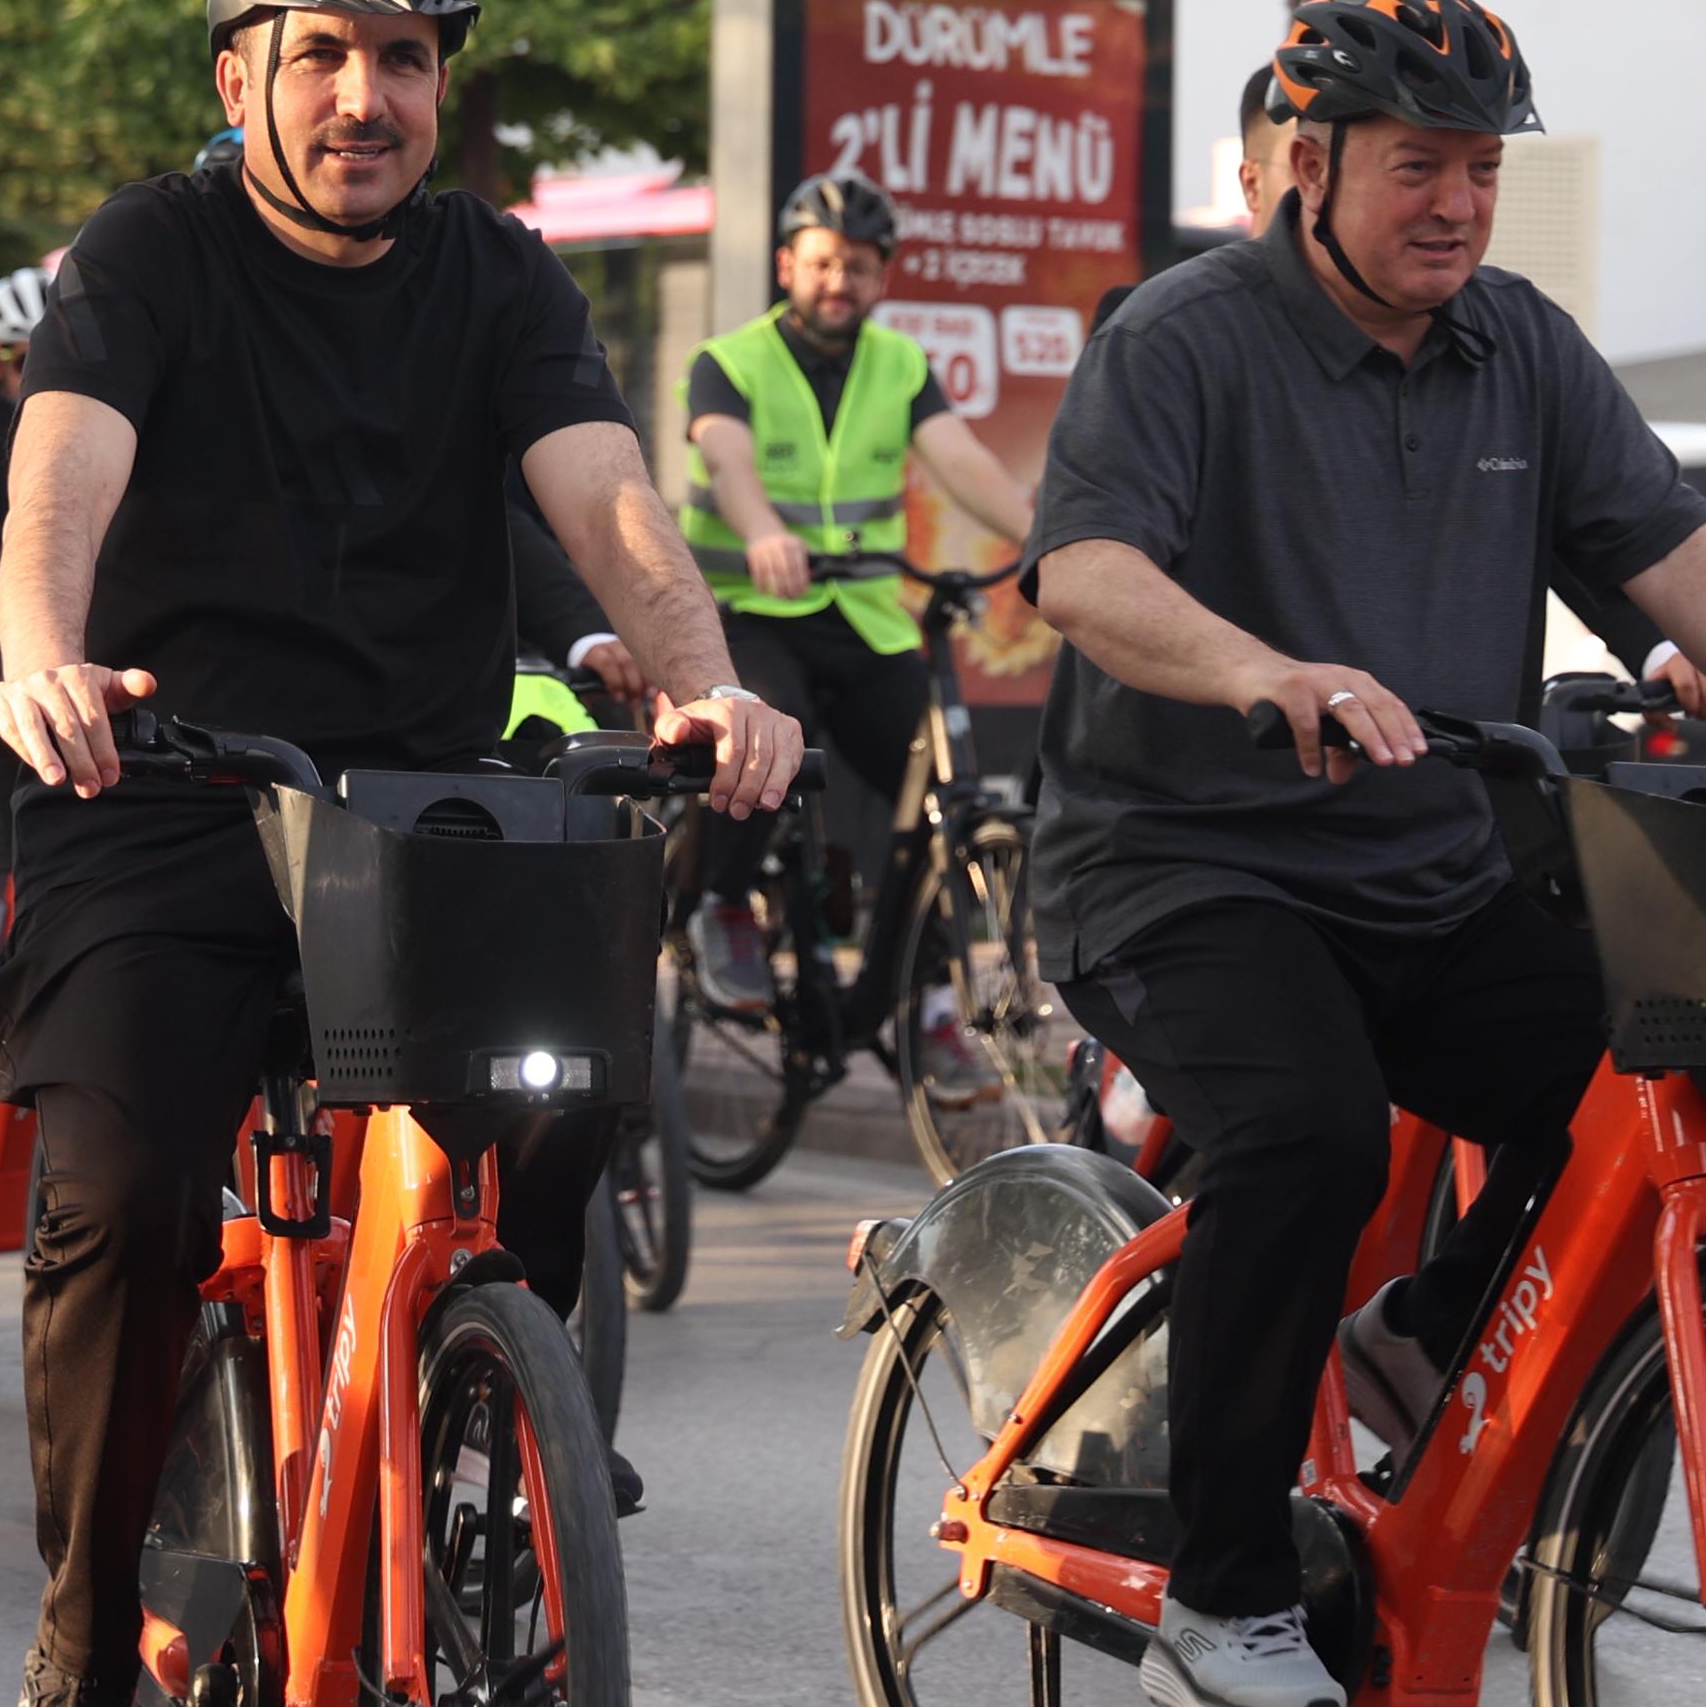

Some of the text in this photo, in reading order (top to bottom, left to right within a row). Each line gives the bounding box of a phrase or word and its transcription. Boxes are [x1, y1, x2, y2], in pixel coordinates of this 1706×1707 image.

[830, 79, 1113, 204] 2'Lİ MENÜ
[326, 1292, 357, 1430] tripy
[1479, 1245, 1554, 1373] tripy
